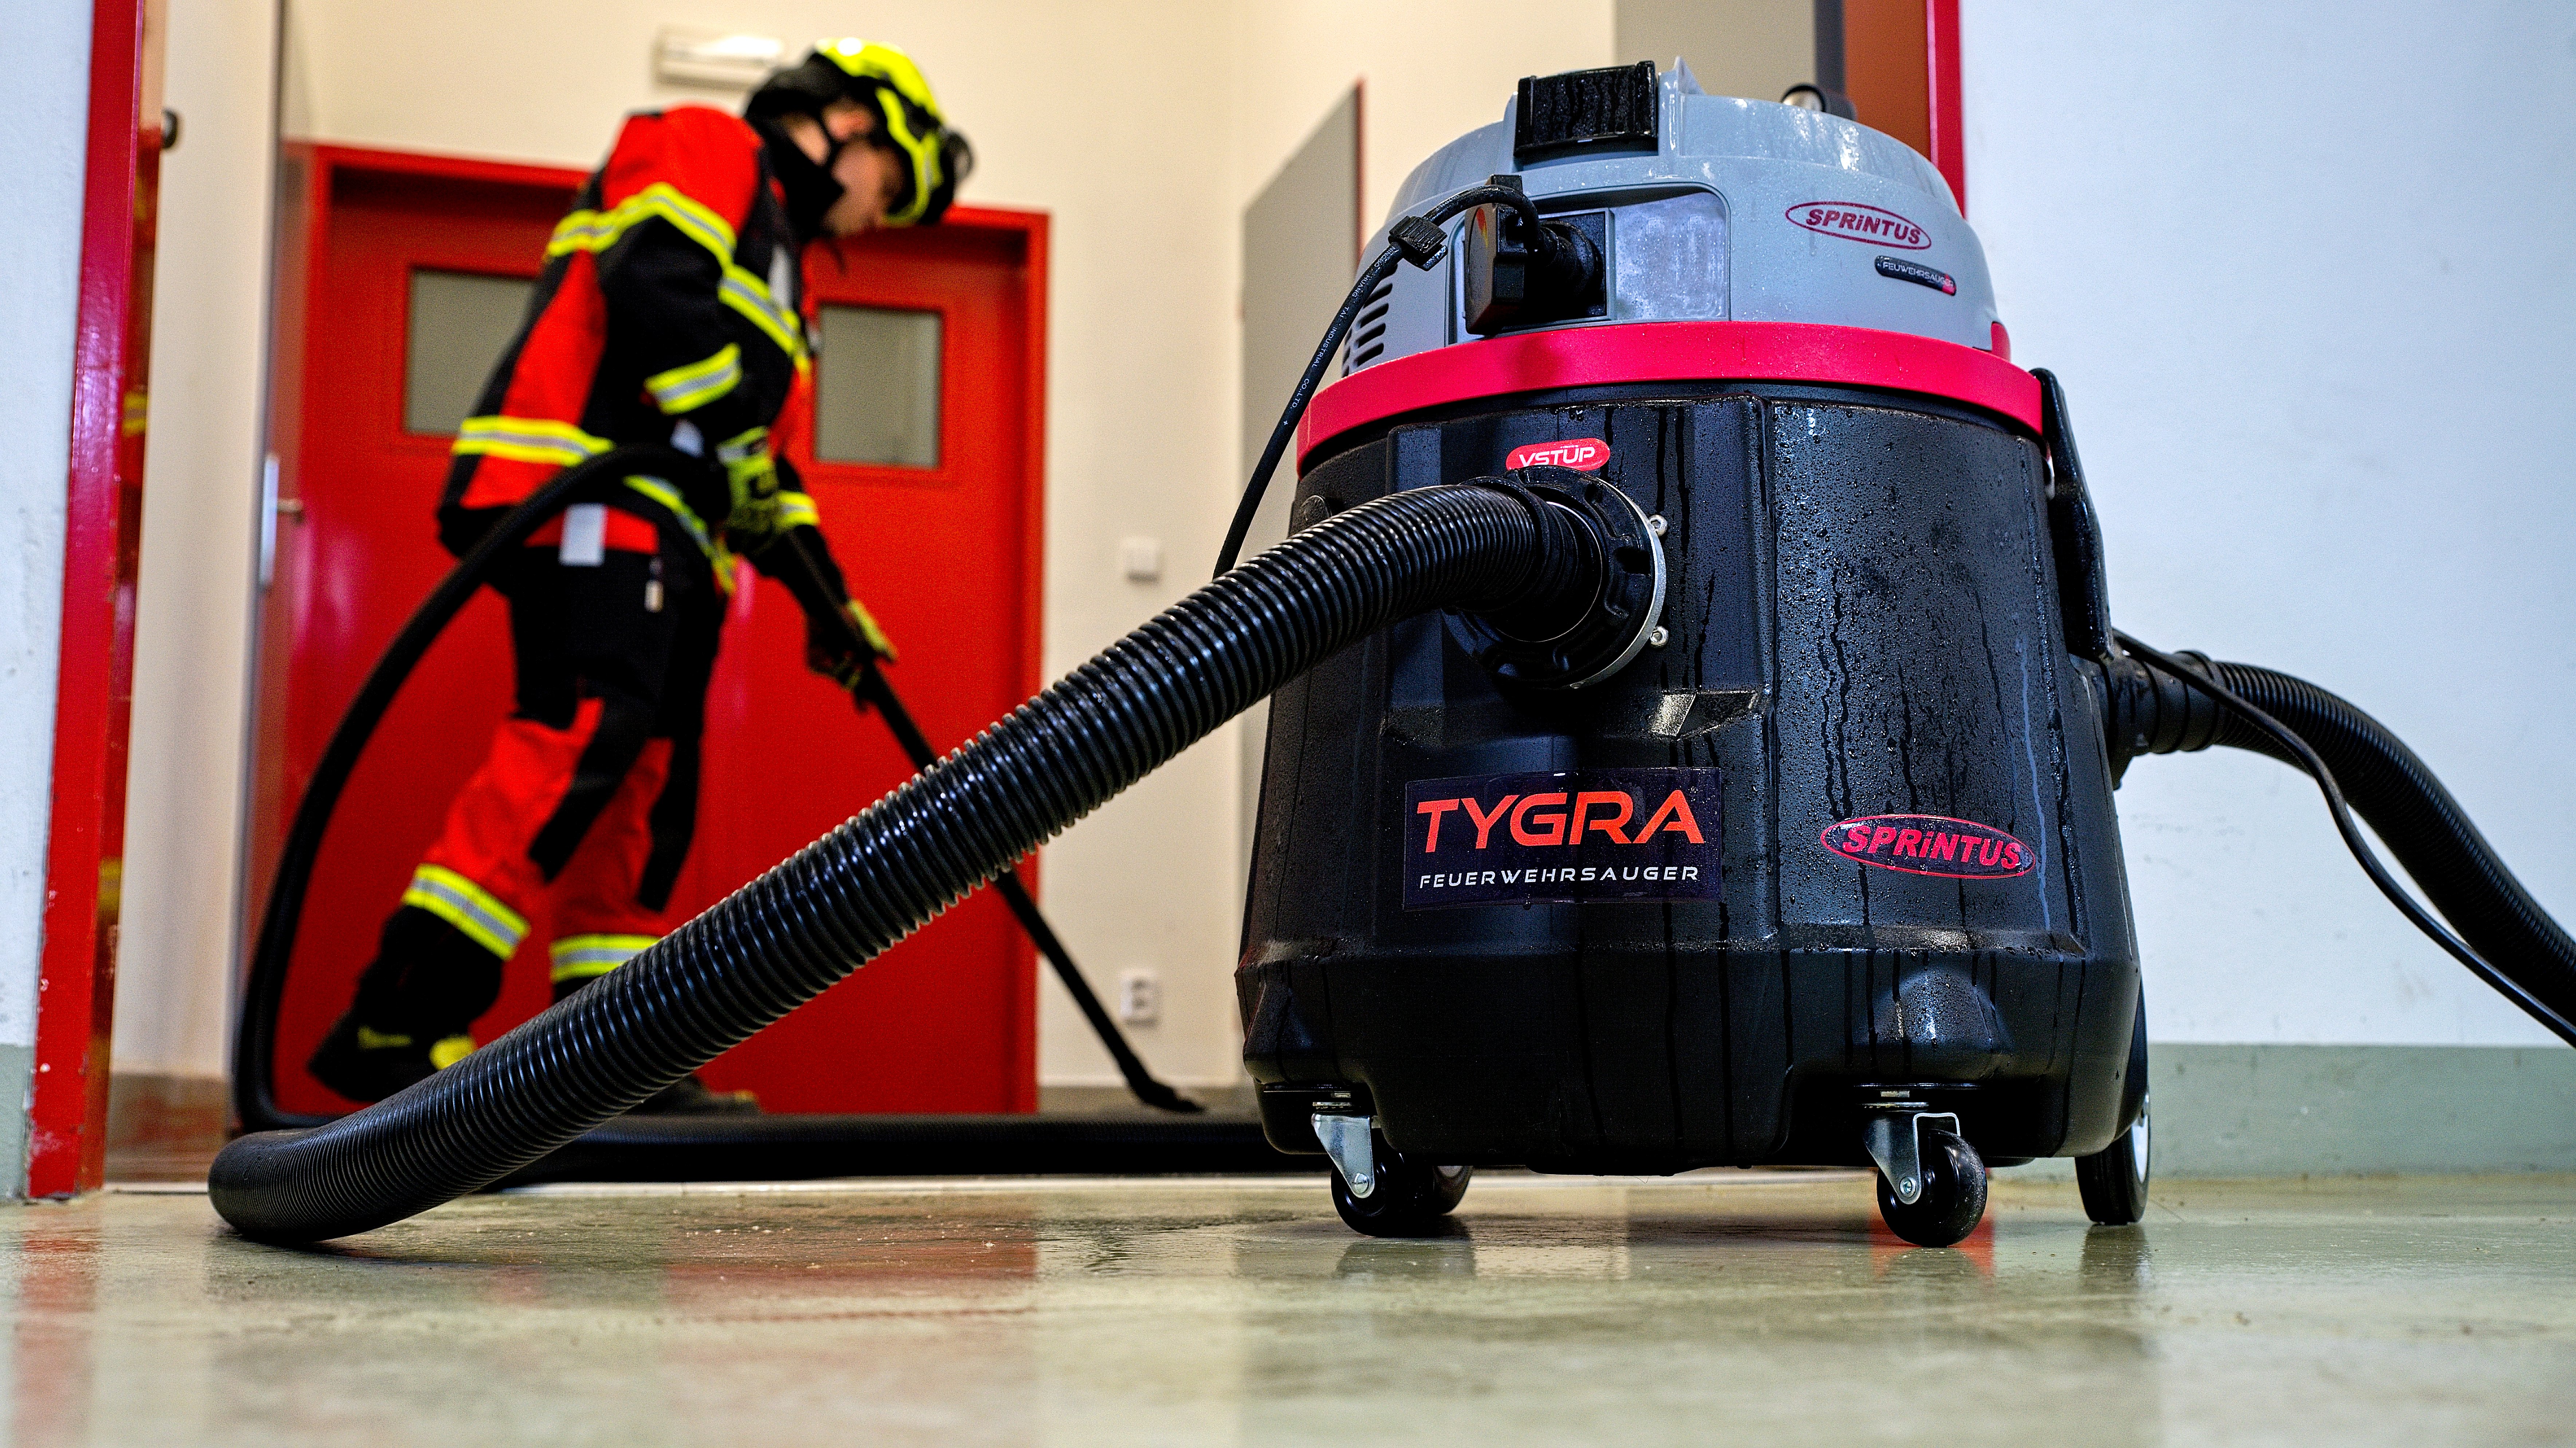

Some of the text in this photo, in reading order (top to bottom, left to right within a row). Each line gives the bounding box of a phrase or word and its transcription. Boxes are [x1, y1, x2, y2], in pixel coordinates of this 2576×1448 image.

[1352, 275, 1370, 298] HUANG
[1339, 307, 1350, 318] TAI
[1312, 327, 1338, 368] INDUSTRIAL
[1519, 446, 1595, 467] VSTUP
[1417, 790, 1705, 853] TYGRA
[1419, 866, 1698, 889] FEUERWEHRSAUGER
